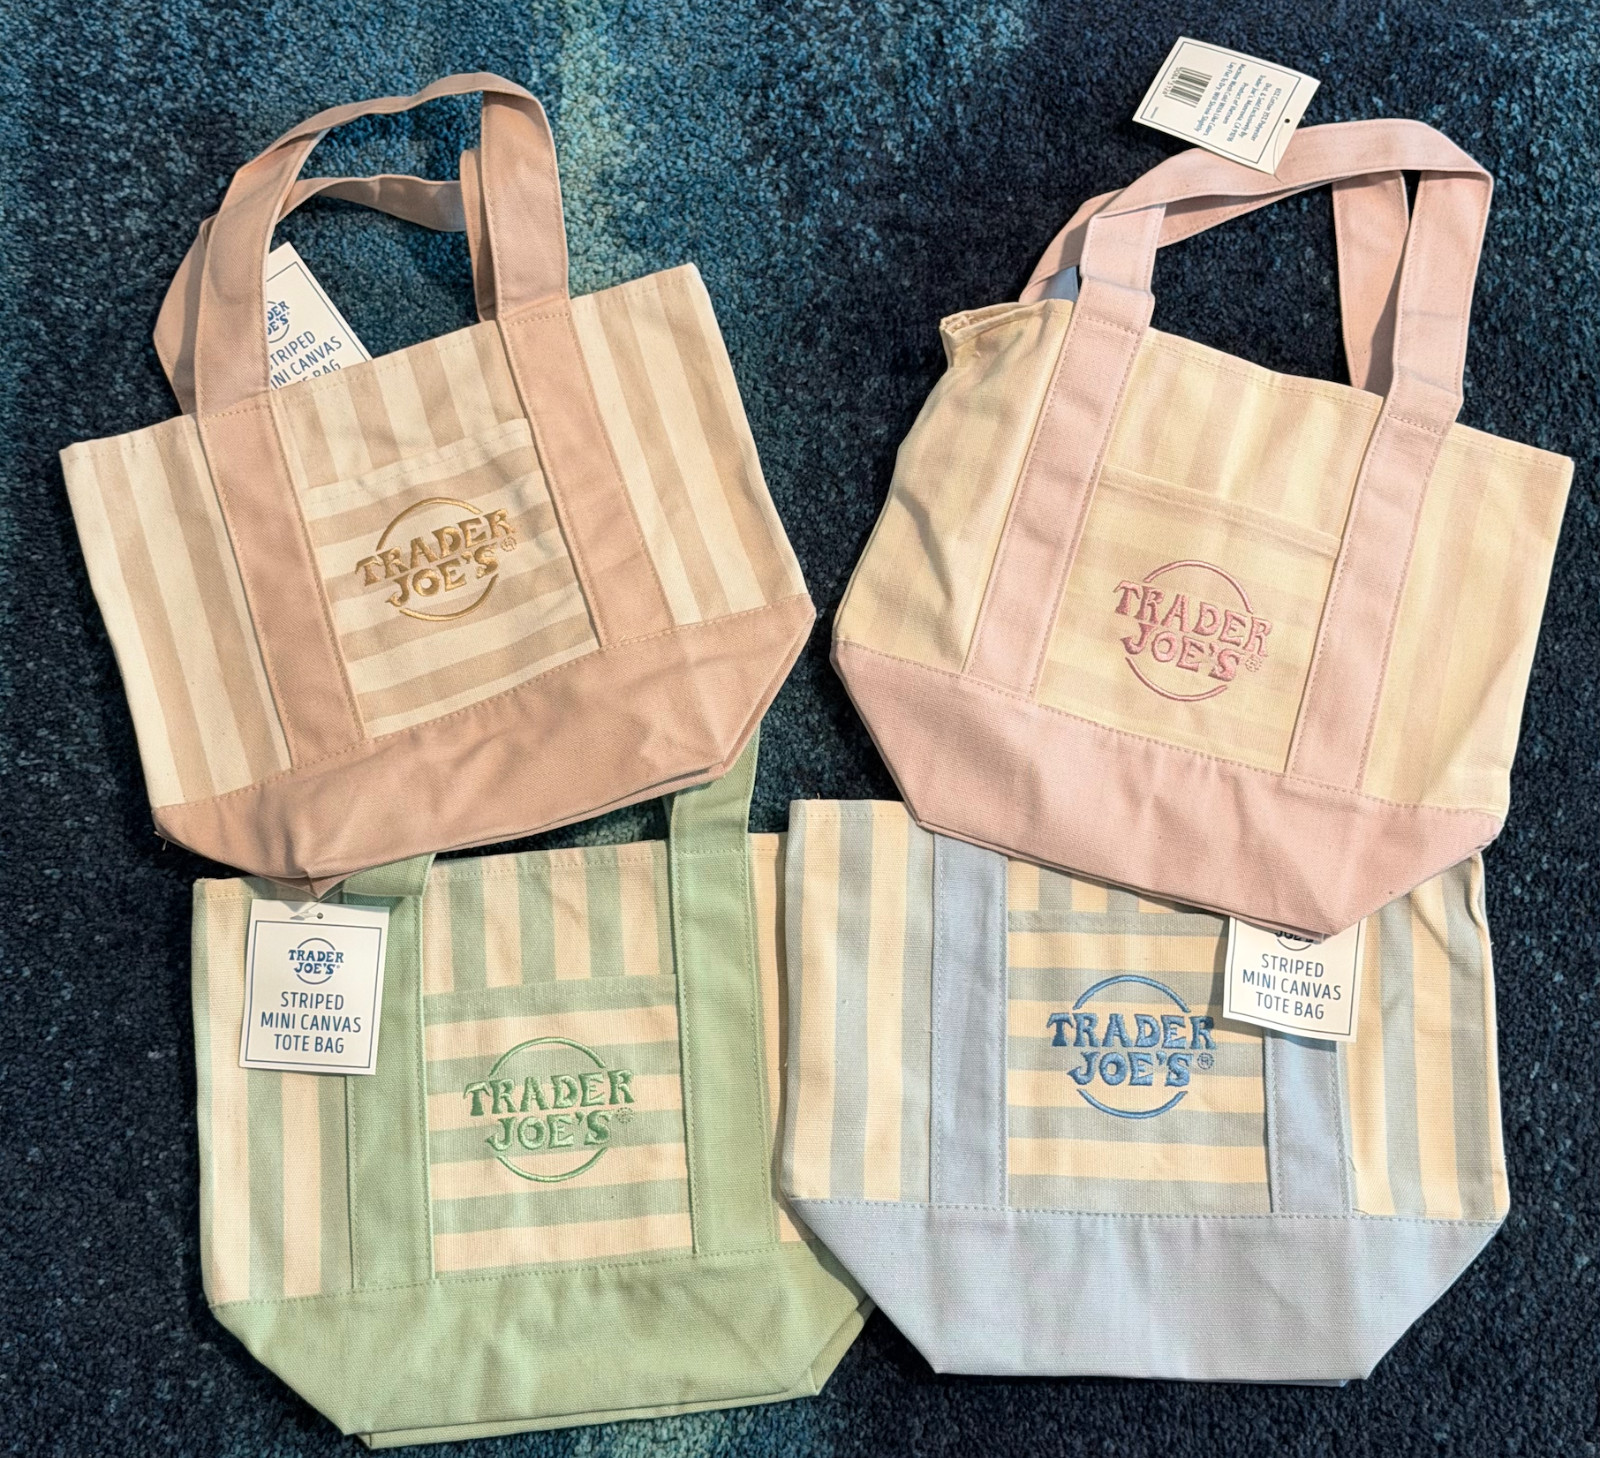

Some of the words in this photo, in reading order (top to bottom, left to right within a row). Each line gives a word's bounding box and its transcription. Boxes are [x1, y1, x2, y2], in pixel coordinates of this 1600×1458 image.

[1224, 69, 1233, 77] Flat
[1227, 61, 1237, 69] Lay
[1233, 63, 1246, 80] Machine
[1227, 80, 1237, 91] Wash
[1255, 74, 1266, 87] Trader
[1212, 91, 1221, 101] Will
[1222, 92, 1231, 102] Cold
[1236, 82, 1249, 99] Product
[1204, 100, 1216, 115] Shrink
[1216, 102, 1225, 113] With
[1255, 96, 1265, 107] Sold
[1211, 113, 1220, 123] Like
[1223, 105, 1236, 124] Vietnam
[1242, 106, 1260, 132] Exclusively
[1249, 119, 1266, 141] Polyester
[267, 301, 290, 322] DER
[270, 331, 316, 370] TRIPED
[270, 369, 291, 390] INI
[290, 336, 342, 376] CANVAS
[355, 508, 517, 586] TRADER
[1113, 580, 1273, 657] TRADER
[288, 949, 344, 963] TRADER
[1261, 953, 1324, 977] STRIPED
[294, 962, 336, 975] JOE'S
[1242, 969, 1276, 990] MINI
[1281, 978, 1341, 1001] CANVAS
[280, 991, 344, 1010] STRIPED
[1256, 991, 1290, 1014] TOTE
[1294, 1001, 1324, 1020] BAG
[260, 1011, 296, 1029] MINI
[300, 1014, 362, 1033] CANVAS
[1046, 1012, 1217, 1050] TRADER
[274, 1033, 310, 1051] TOTE
[314, 1036, 345, 1053] BAG
[463, 1069, 635, 1116] TRADER
